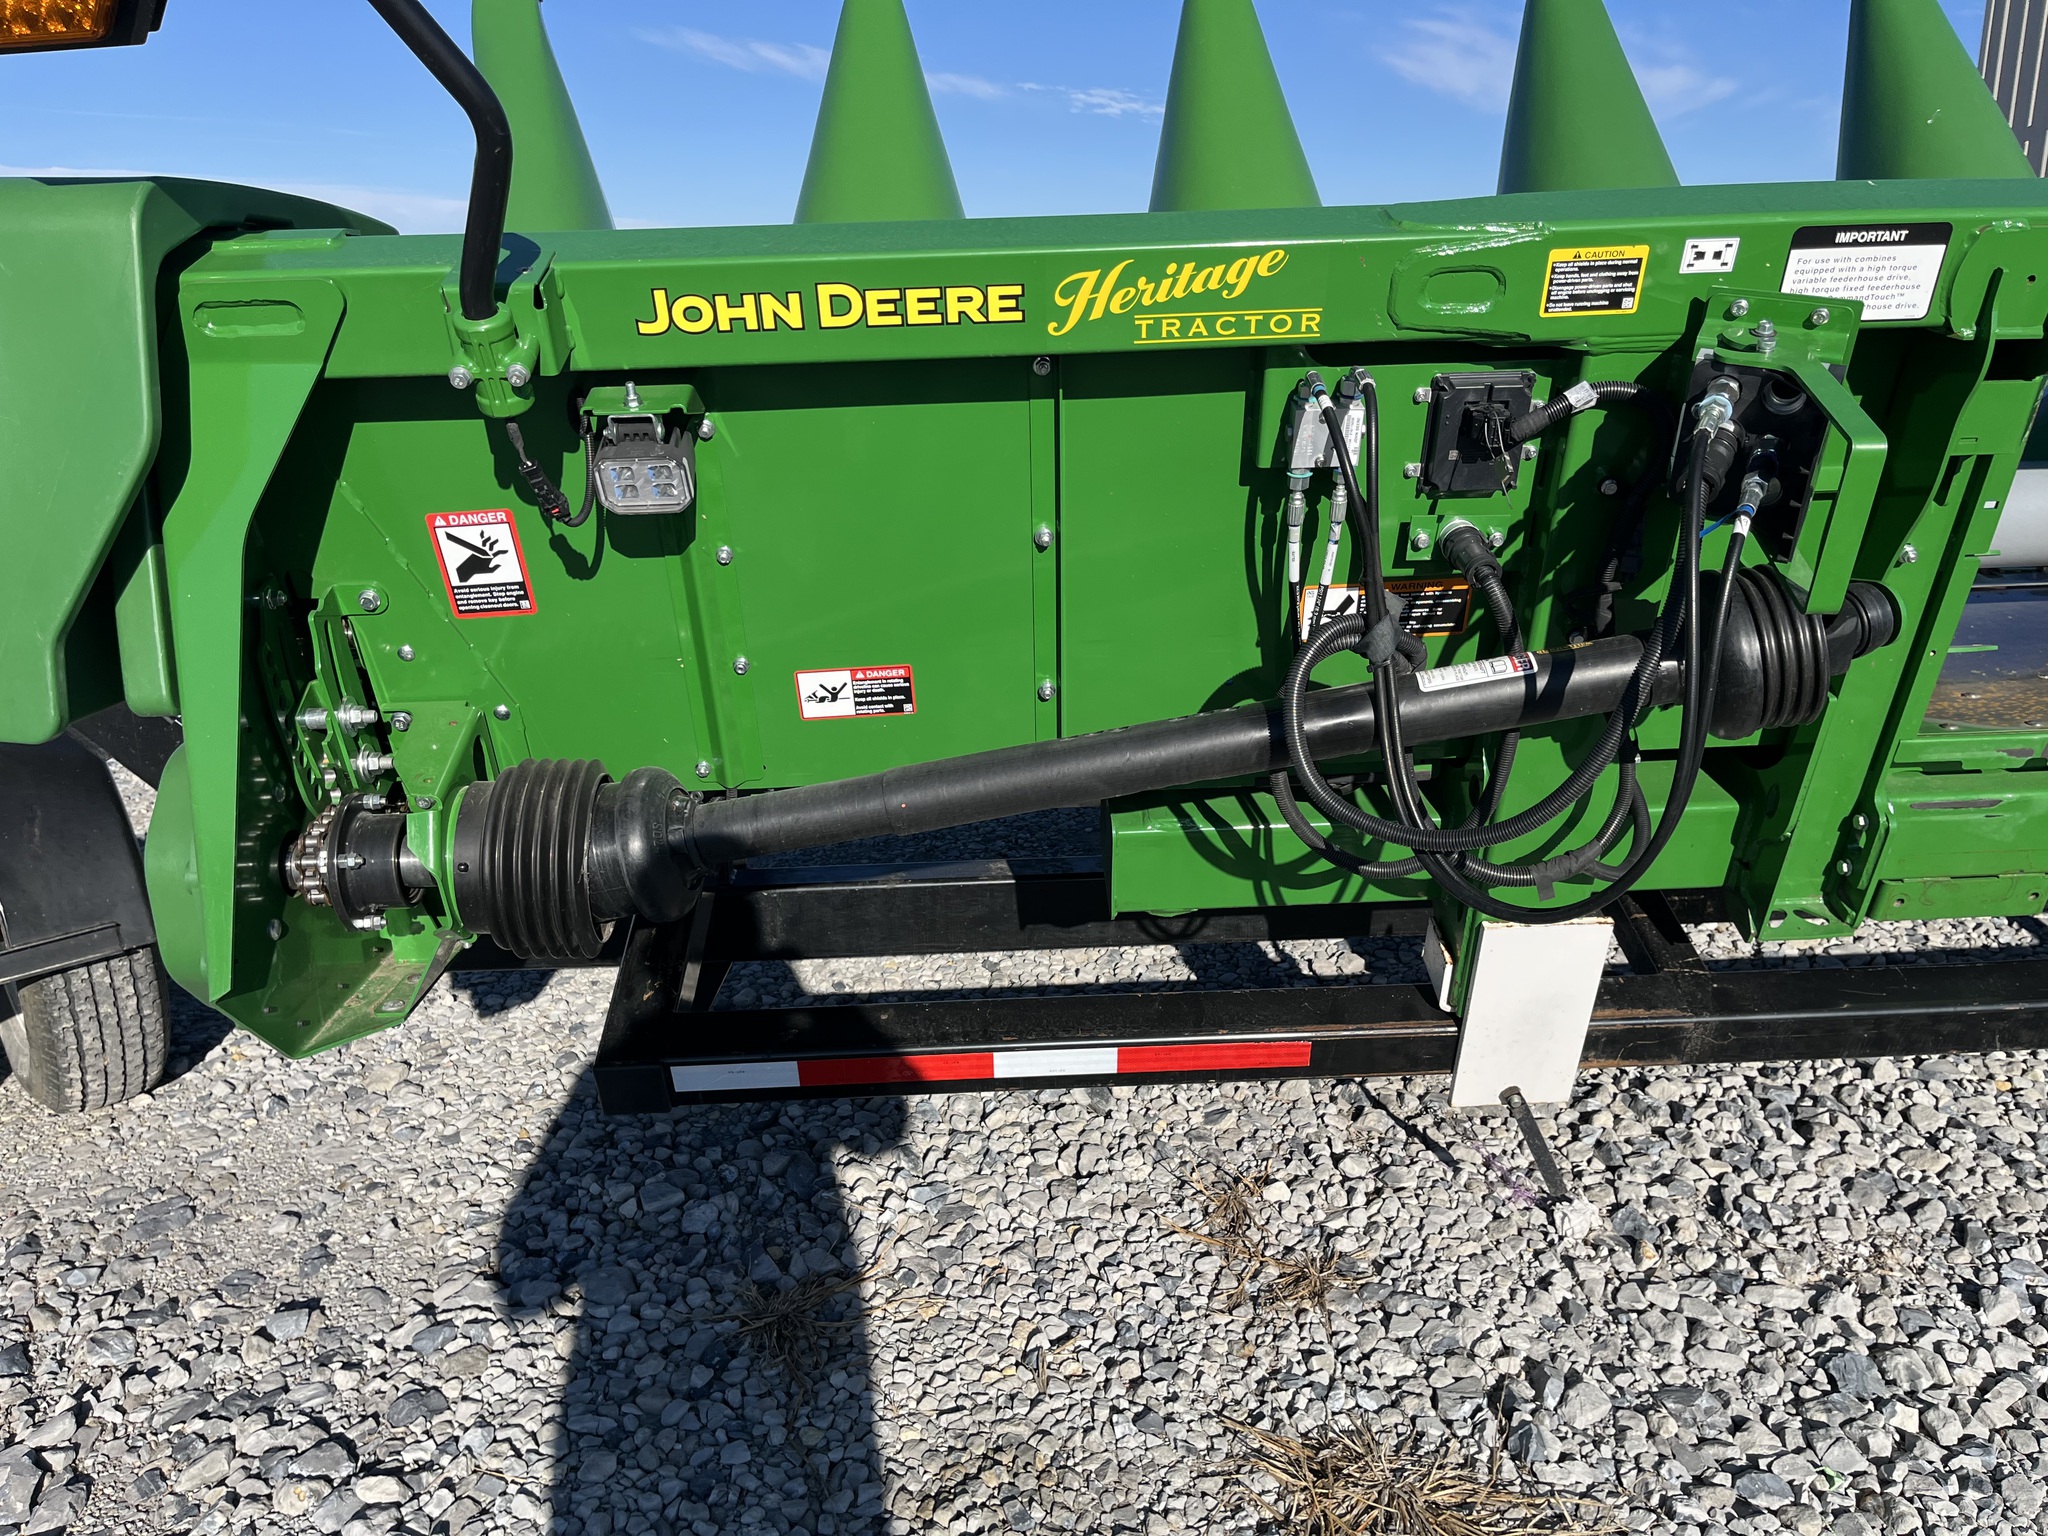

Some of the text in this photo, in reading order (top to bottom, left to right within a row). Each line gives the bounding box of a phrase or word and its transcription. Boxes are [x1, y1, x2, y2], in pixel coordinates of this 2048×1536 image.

[1835, 230, 1909, 243] IMPORTANT
[1585, 250, 1625, 259] CAUTION
[1794, 267, 1835, 275] equipped
[1867, 265, 1886, 273] high
[1792, 276, 1827, 284] variable
[1830, 274, 1884, 283] feederhouse
[1867, 283, 1921, 291] feederhouse
[1047, 249, 1289, 336] Heritage
[636, 282, 1026, 336] JOHN DEERE
[1134, 311, 1322, 340] TRACTOR
[448, 512, 507, 525] DANGER
[1391, 582, 1443, 590] WARNING
[866, 669, 905, 677] DANGER
